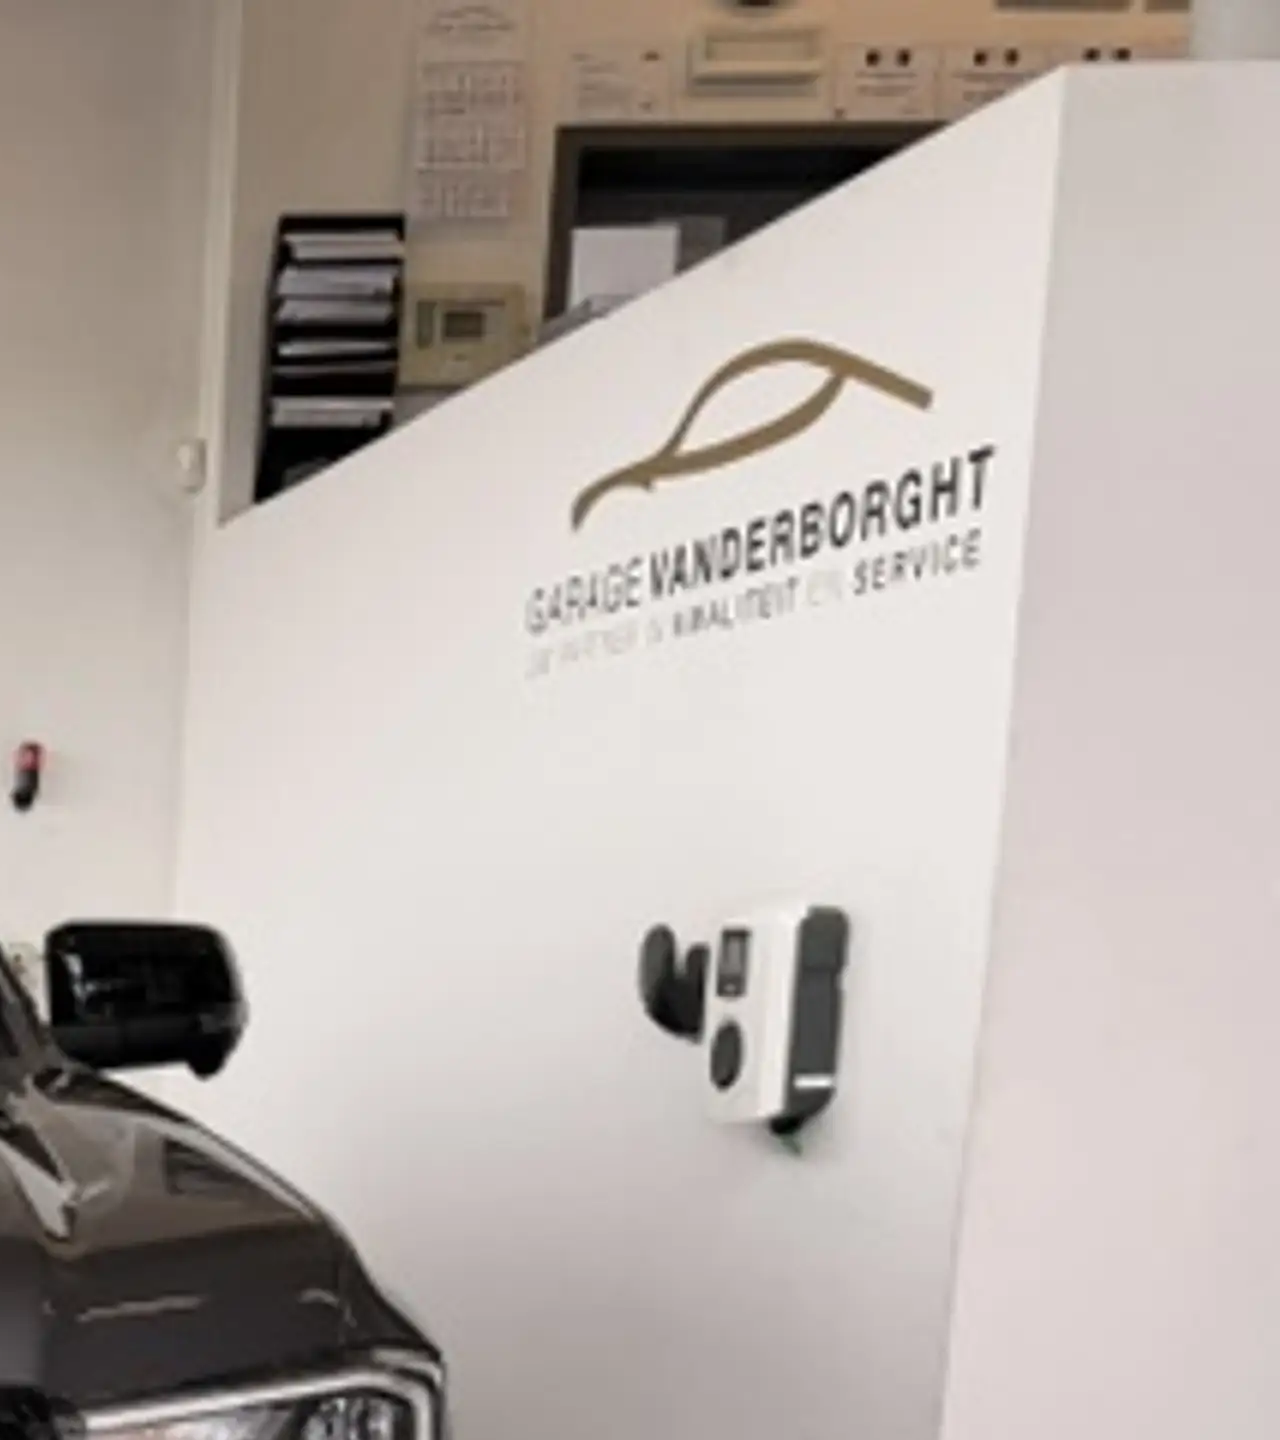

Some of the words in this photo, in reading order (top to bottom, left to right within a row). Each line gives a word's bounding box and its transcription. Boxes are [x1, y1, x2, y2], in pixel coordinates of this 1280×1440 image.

[525, 557, 643, 635] GARAGE
[649, 444, 996, 599] VANDERBORGHT
[853, 528, 983, 596] SERVICE
